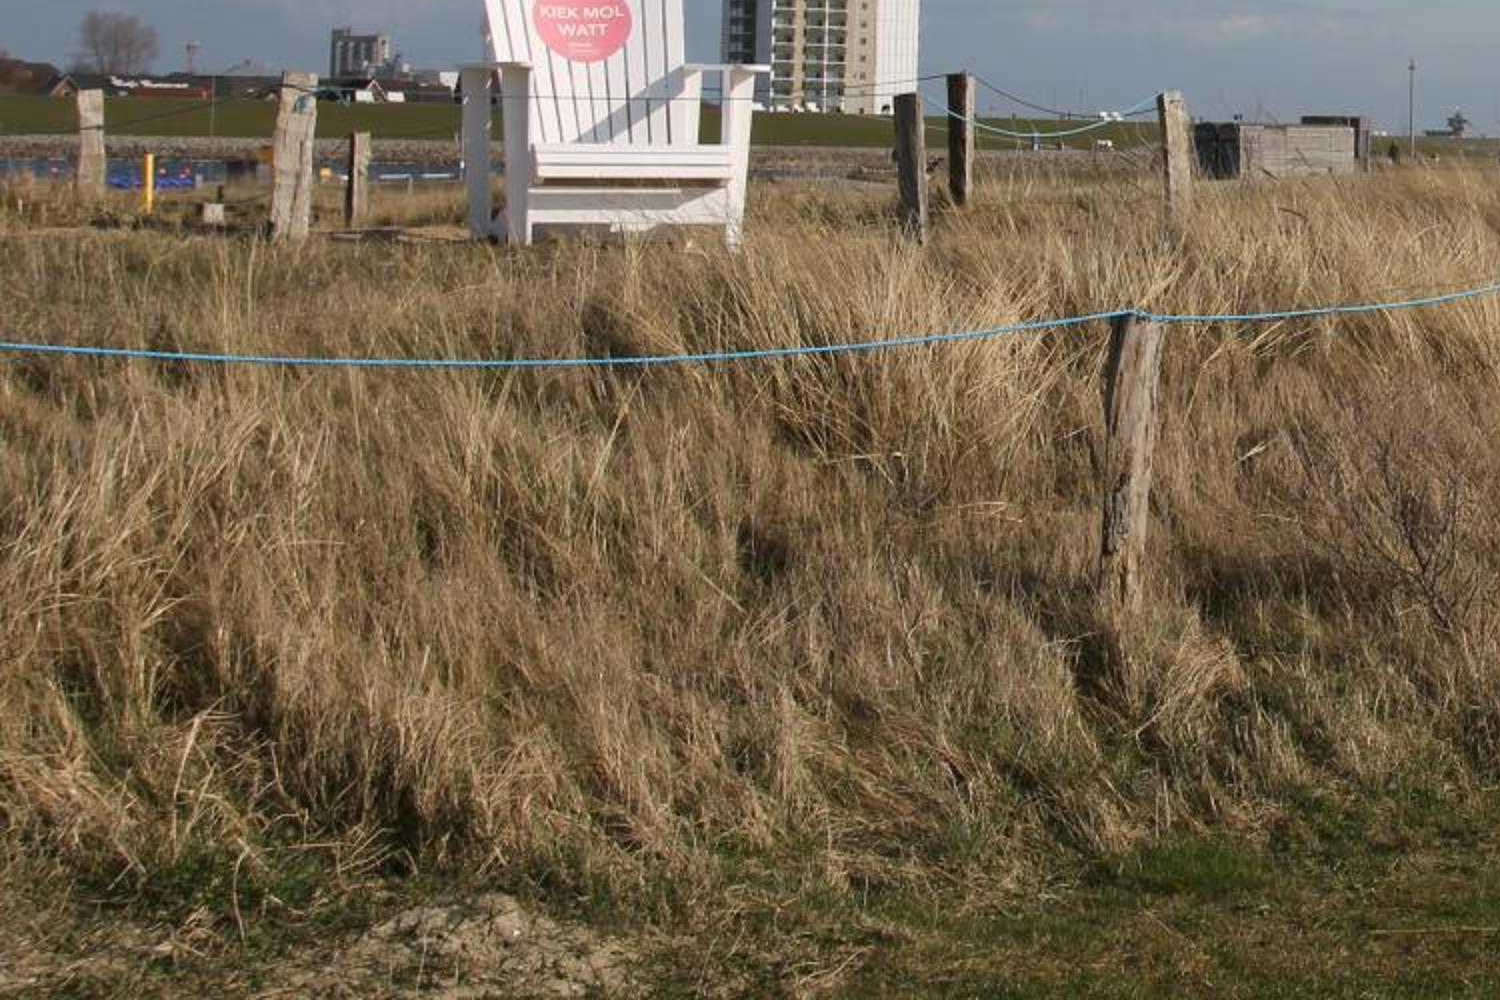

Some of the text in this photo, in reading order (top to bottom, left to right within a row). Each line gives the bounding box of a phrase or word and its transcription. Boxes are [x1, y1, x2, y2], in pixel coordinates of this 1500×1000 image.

[539, 4, 625, 19] KIEK MOL
[558, 23, 608, 37] WATT
